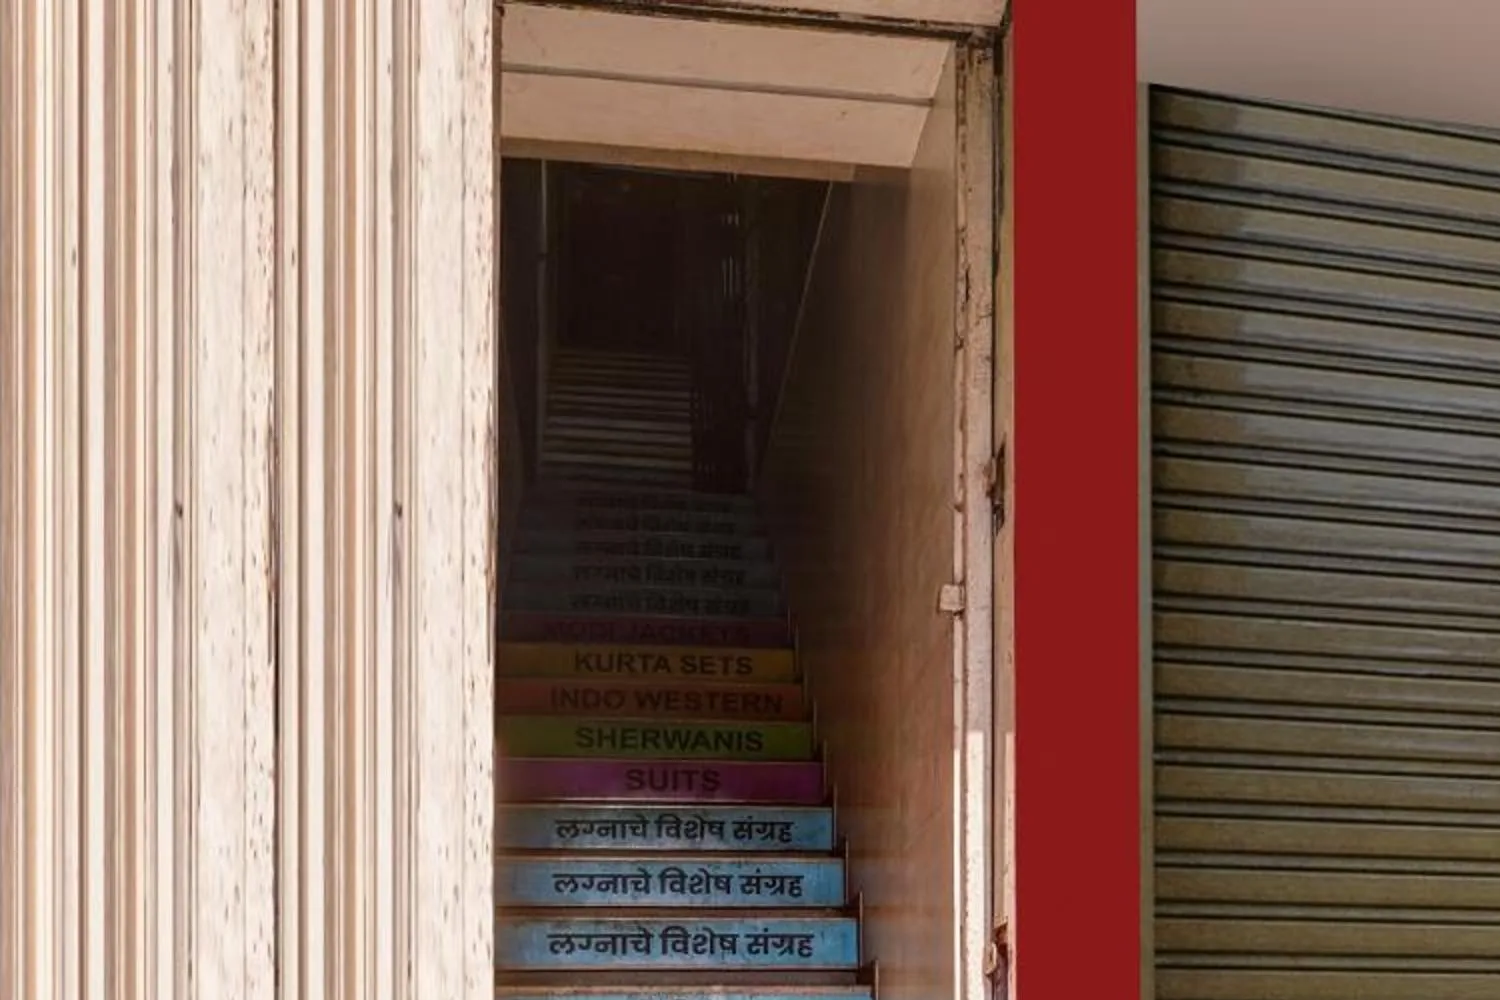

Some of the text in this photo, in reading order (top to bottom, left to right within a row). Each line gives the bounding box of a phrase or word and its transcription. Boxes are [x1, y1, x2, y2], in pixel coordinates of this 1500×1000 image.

[574, 653, 753, 676] KURTA SETS
[550, 687, 783, 714] INDO WESTERN
[575, 727, 764, 753] SHERWANIS
[626, 768, 721, 792] SUITS
[555, 813, 794, 843] लग्नाचे विशेष संग्रह
[552, 867, 804, 899] लग्नाचे विशेष संग्रह
[547, 925, 814, 958] लग्नाचे विशेष संग्रह
